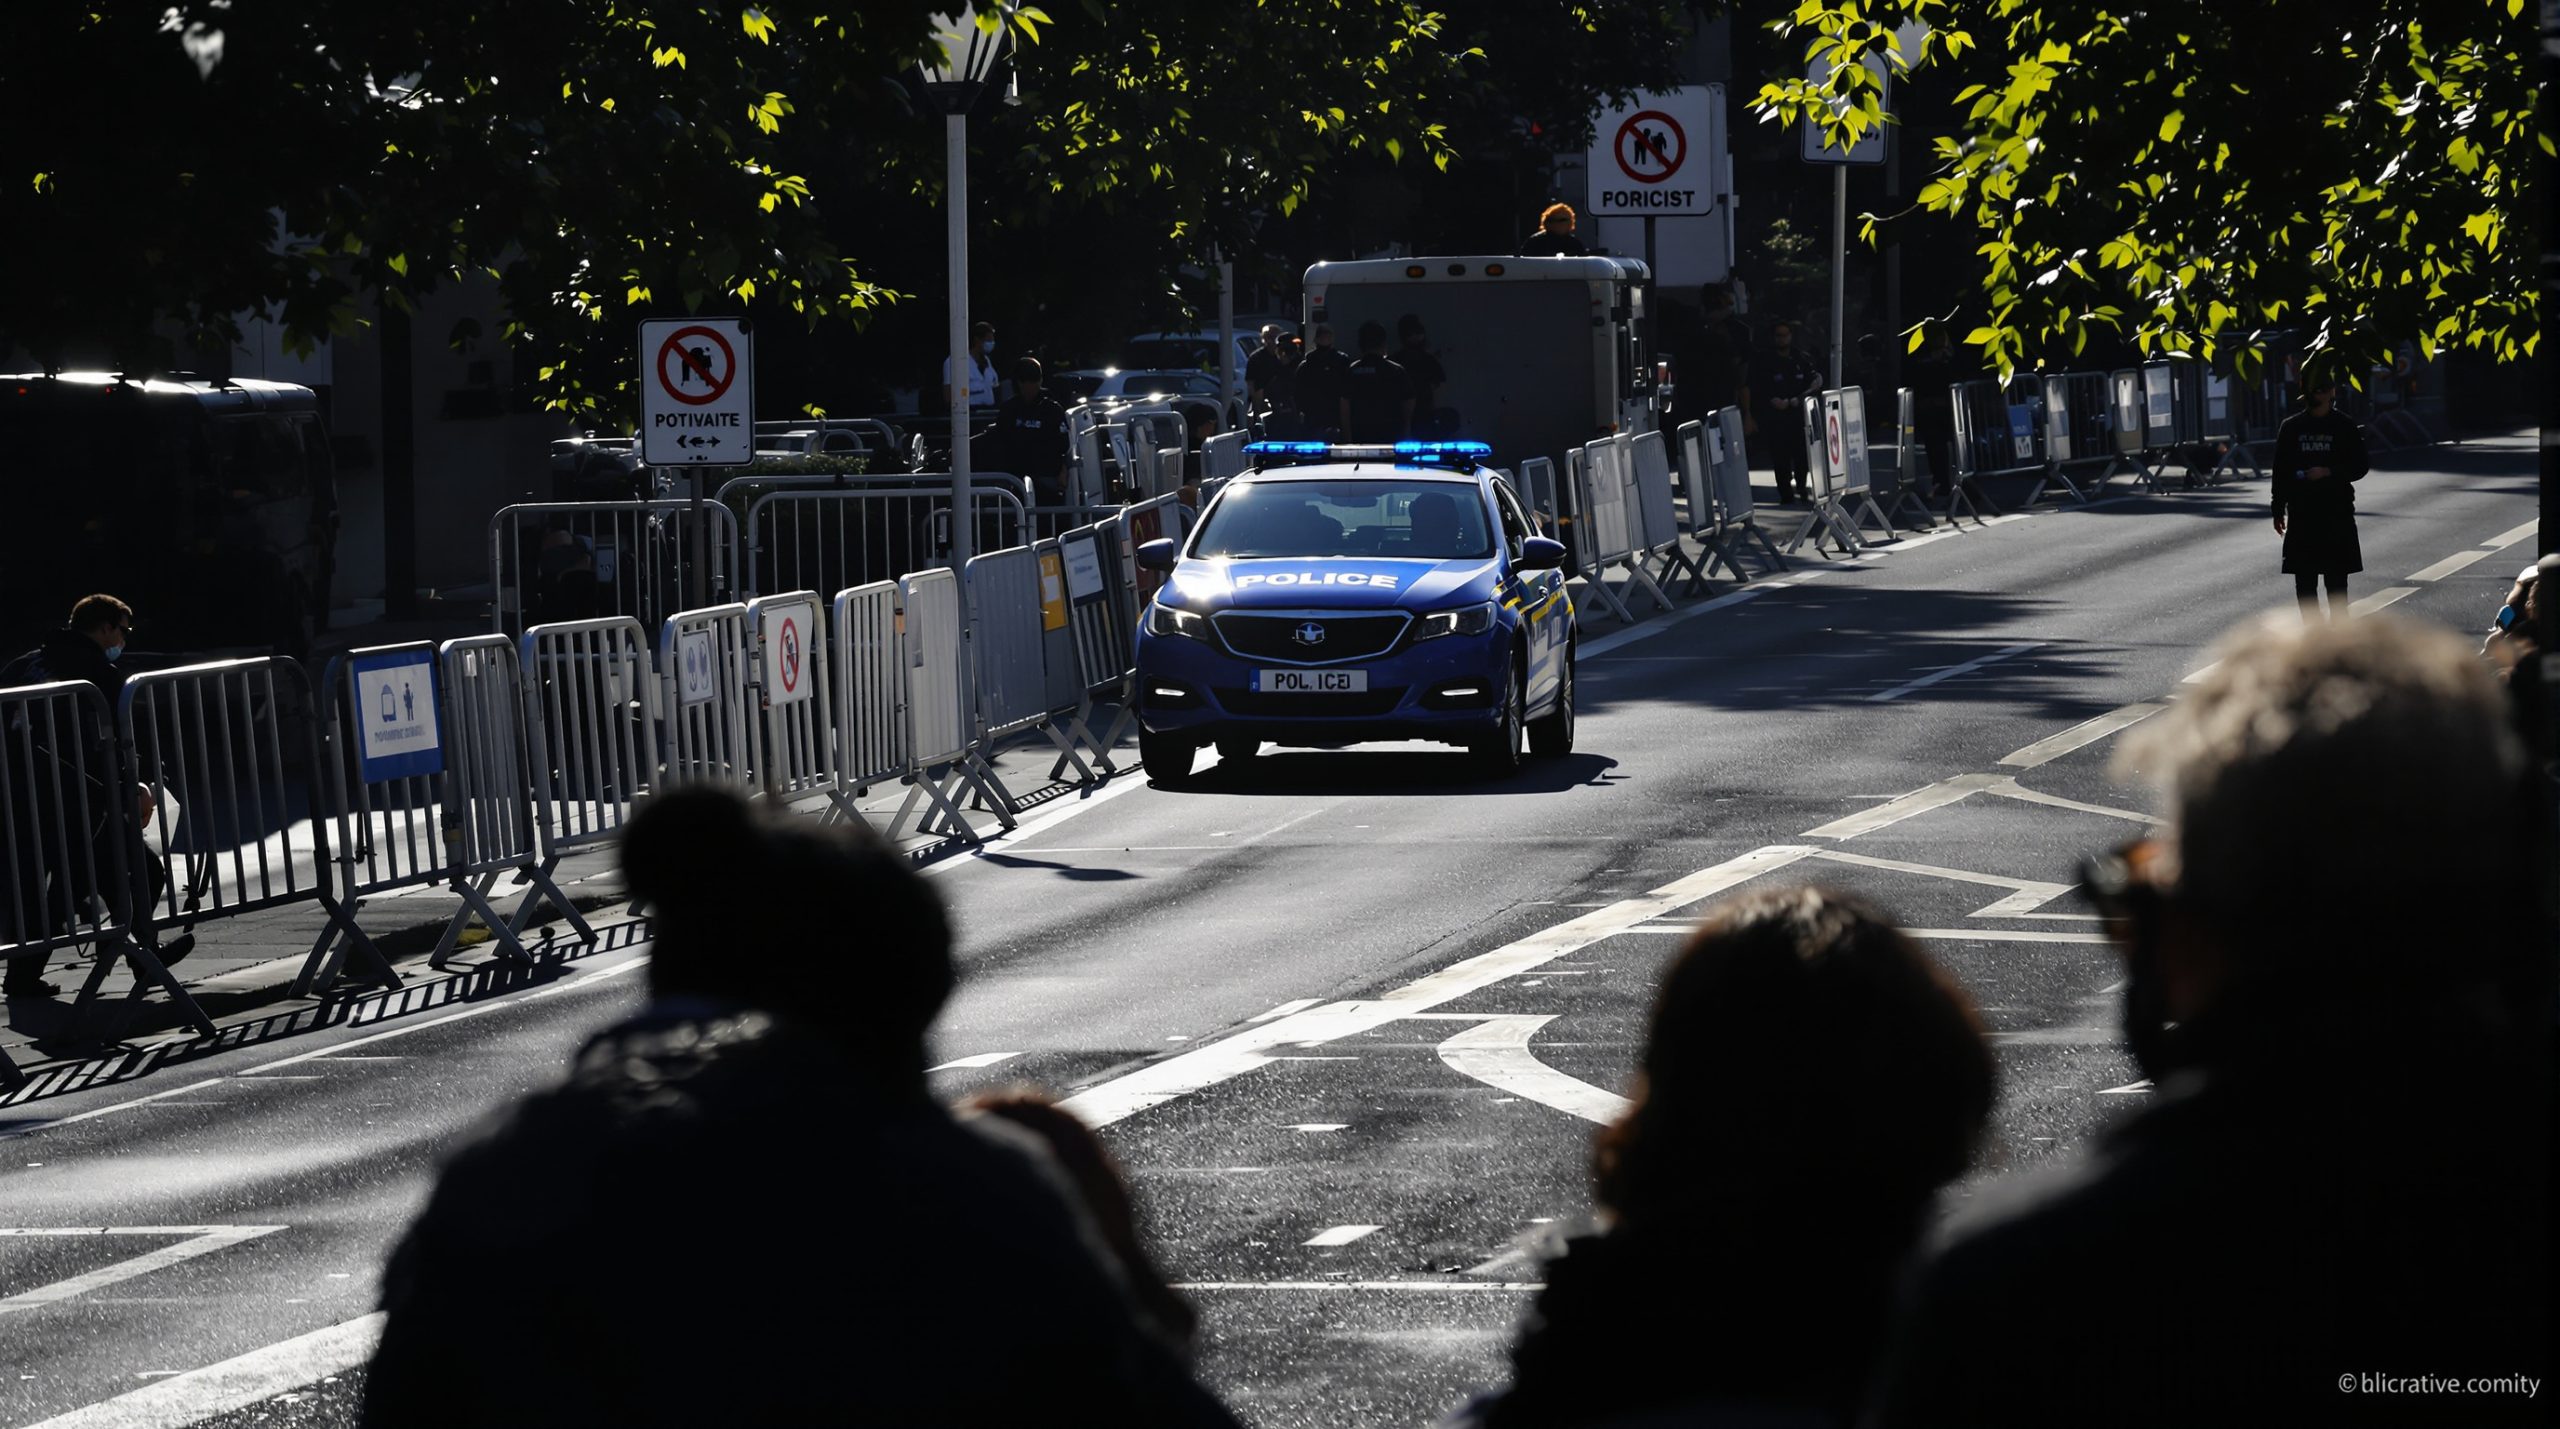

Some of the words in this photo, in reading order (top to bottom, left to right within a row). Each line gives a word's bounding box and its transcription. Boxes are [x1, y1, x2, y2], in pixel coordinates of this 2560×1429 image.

[1602, 190, 1695, 208] PORICIST
[655, 412, 740, 428] POTIVAITE
[1235, 572, 1399, 589] POLICE
